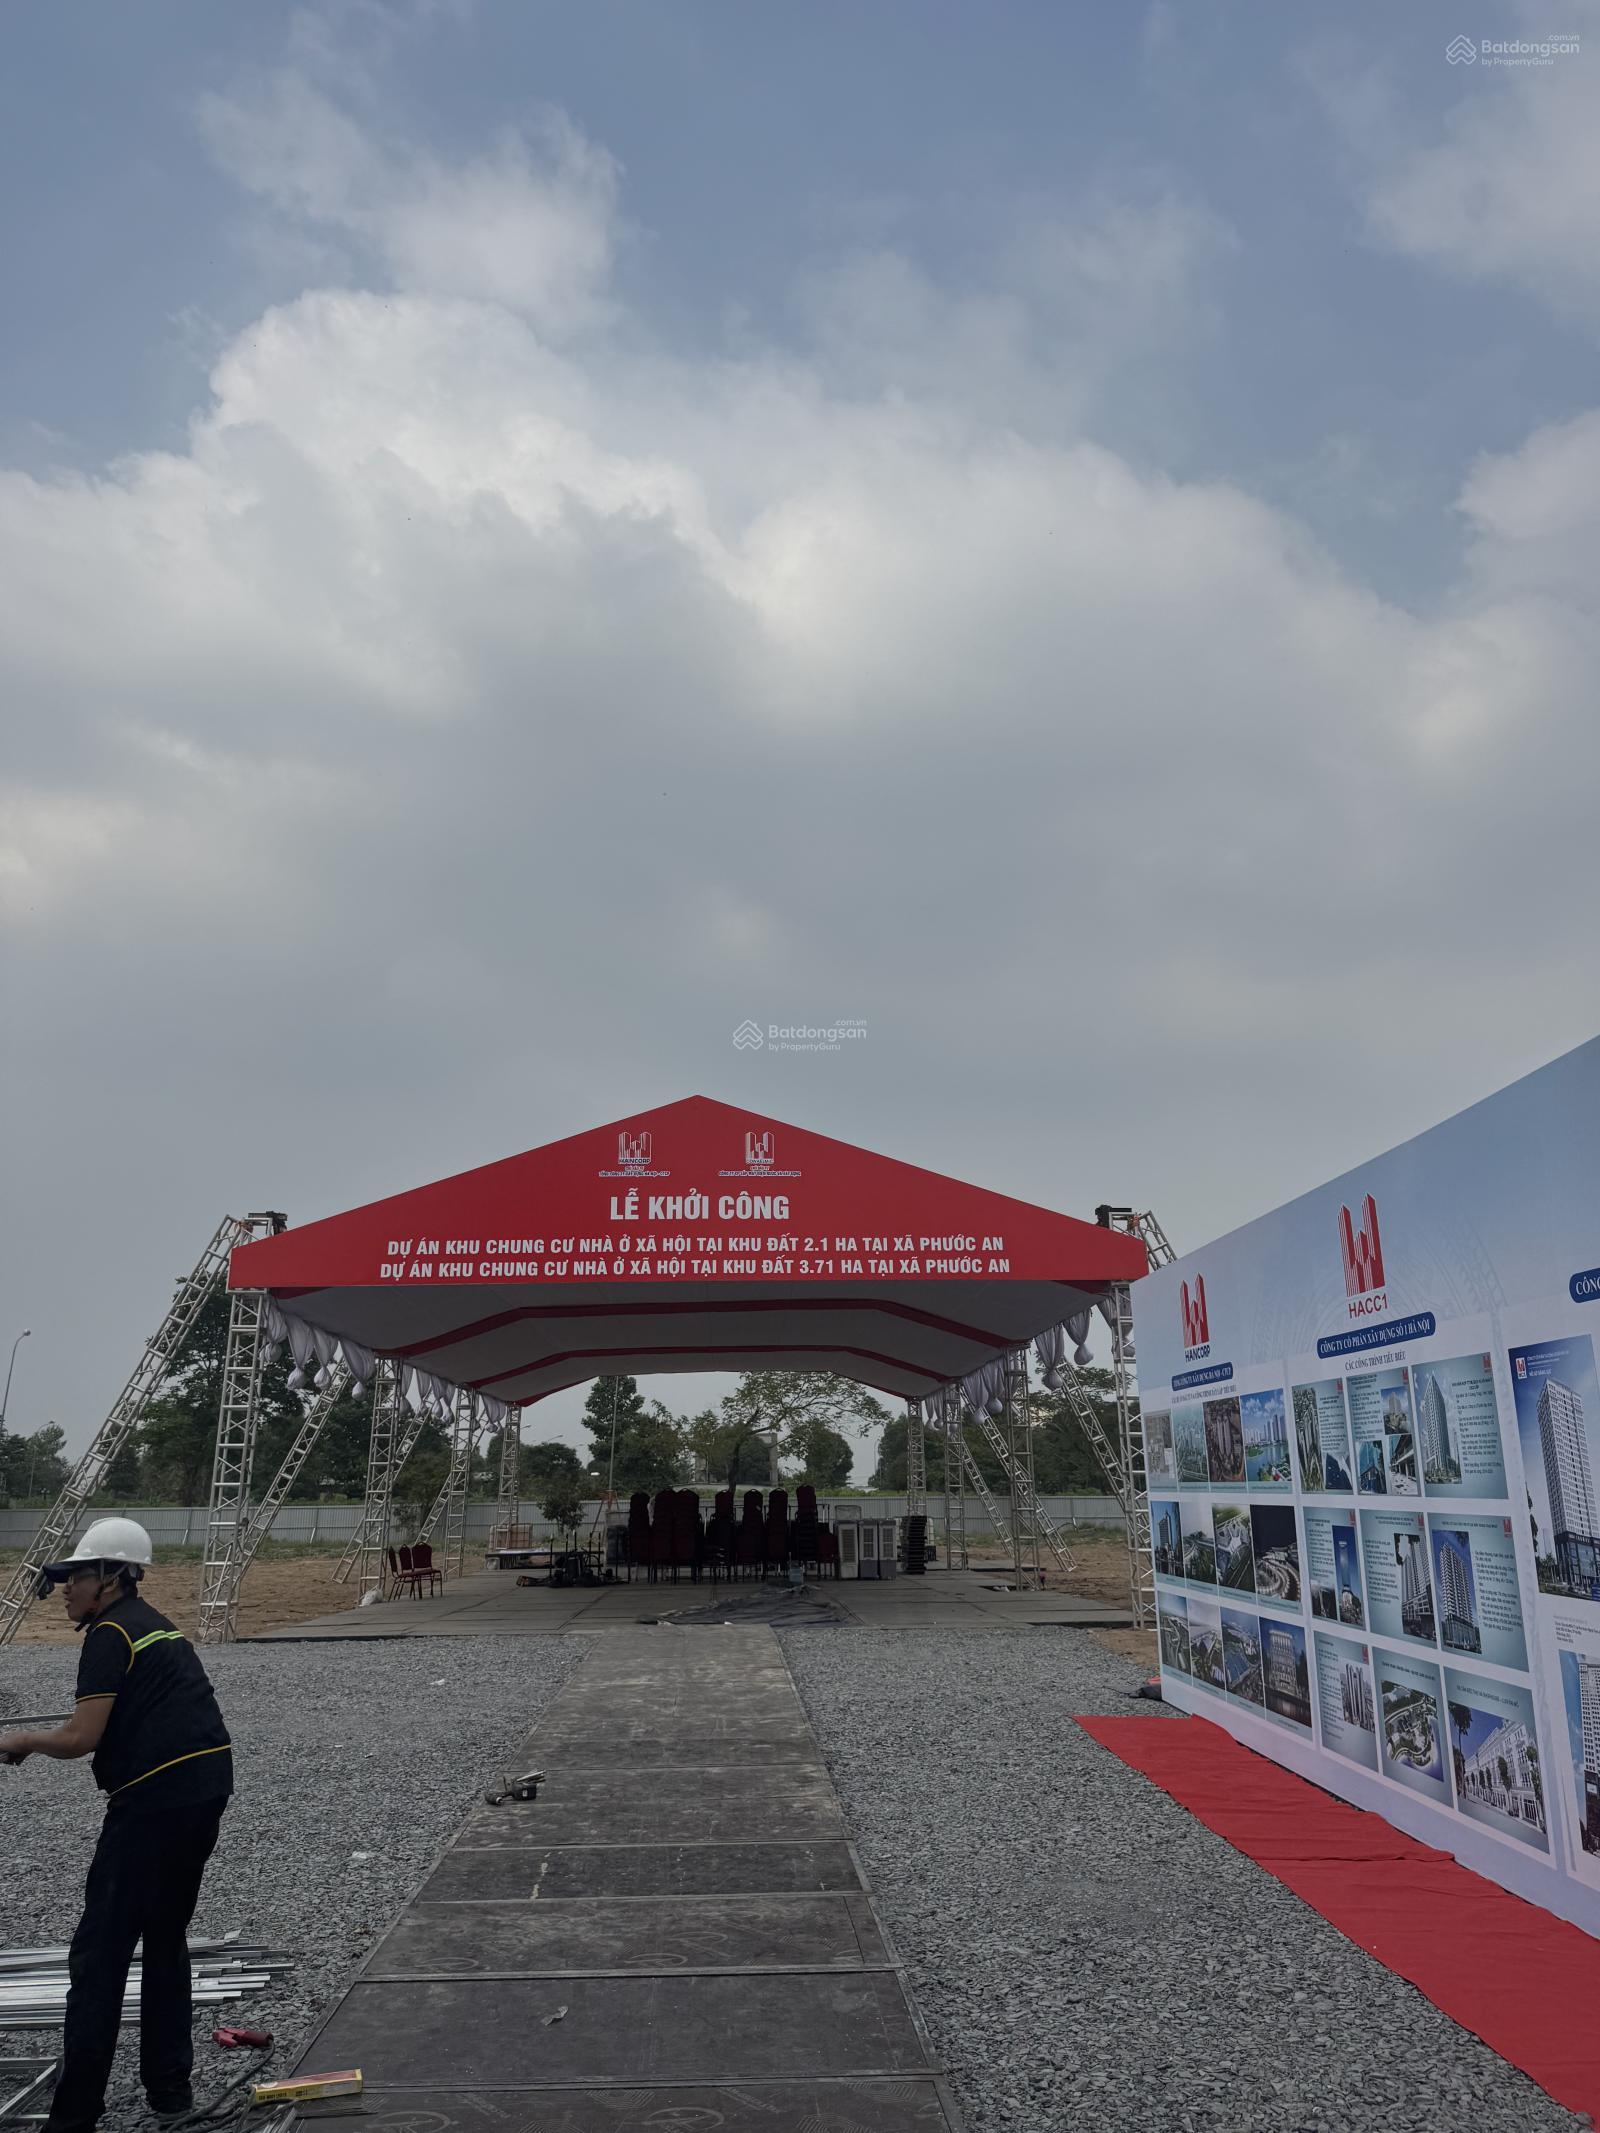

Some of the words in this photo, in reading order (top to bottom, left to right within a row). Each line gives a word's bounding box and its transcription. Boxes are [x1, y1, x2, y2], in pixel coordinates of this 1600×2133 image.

[610, 1188, 640, 1220] LỄ
[649, 1188, 709, 1220] KHỞI
[718, 1191, 790, 1220] CÔNG
[388, 1239, 413, 1258] DỰ
[417, 1237, 439, 1255] ÁN
[446, 1239, 480, 1255] KHU
[486, 1239, 545, 1254] CHUNG
[550, 1237, 576, 1253] CƯ
[580, 1236, 613, 1253] NHÀ
[619, 1234, 630, 1252] Ở
[636, 1235, 657, 1252] XÃ
[663, 1234, 691, 1255] HỘI
[697, 1237, 723, 1255] TẠI
[728, 1237, 761, 1252] KHU
[767, 1233, 799, 1252] ĐẤT
[804, 1237, 829, 1252] 2.1
[836, 1237, 858, 1251] HA
[862, 1237, 888, 1255] TẠI
[893, 1234, 915, 1251] XÃ
[920, 1234, 976, 1251] PHƯỚC
[982, 1237, 1004, 1251] AN
[380, 1262, 405, 1281] DỰ
[410, 1259, 433, 1278] ÁN
[439, 1262, 473, 1278] KHU
[479, 1261, 539, 1277] CHUNG
[544, 1260, 569, 1276] CƯ
[573, 1258, 607, 1275] NHÀ
[613, 1256, 625, 1275] Ở
[630, 1257, 651, 1275] XÃ
[657, 1257, 686, 1278] HỘI
[692, 1260, 717, 1277] TẠI
[723, 1260, 756, 1274] KHU
[761, 1255, 794, 1274] ĐẤT
[799, 1259, 834, 1274] 3.71
[841, 1259, 863, 1274] HA
[868, 1259, 894, 1277] TẠI
[899, 1256, 921, 1274] XÃ
[926, 1255, 983, 1273] PHƯỚC
[988, 1259, 1010, 1273] AN
[1349, 1294, 1388, 1318] HACC1
[1320, 1340, 1336, 1354] CÔNG
[1336, 1339, 1344, 1351] TY
[1417, 1318, 1431, 1334] NỘI
[1185, 1345, 1210, 1362] HANCORP
